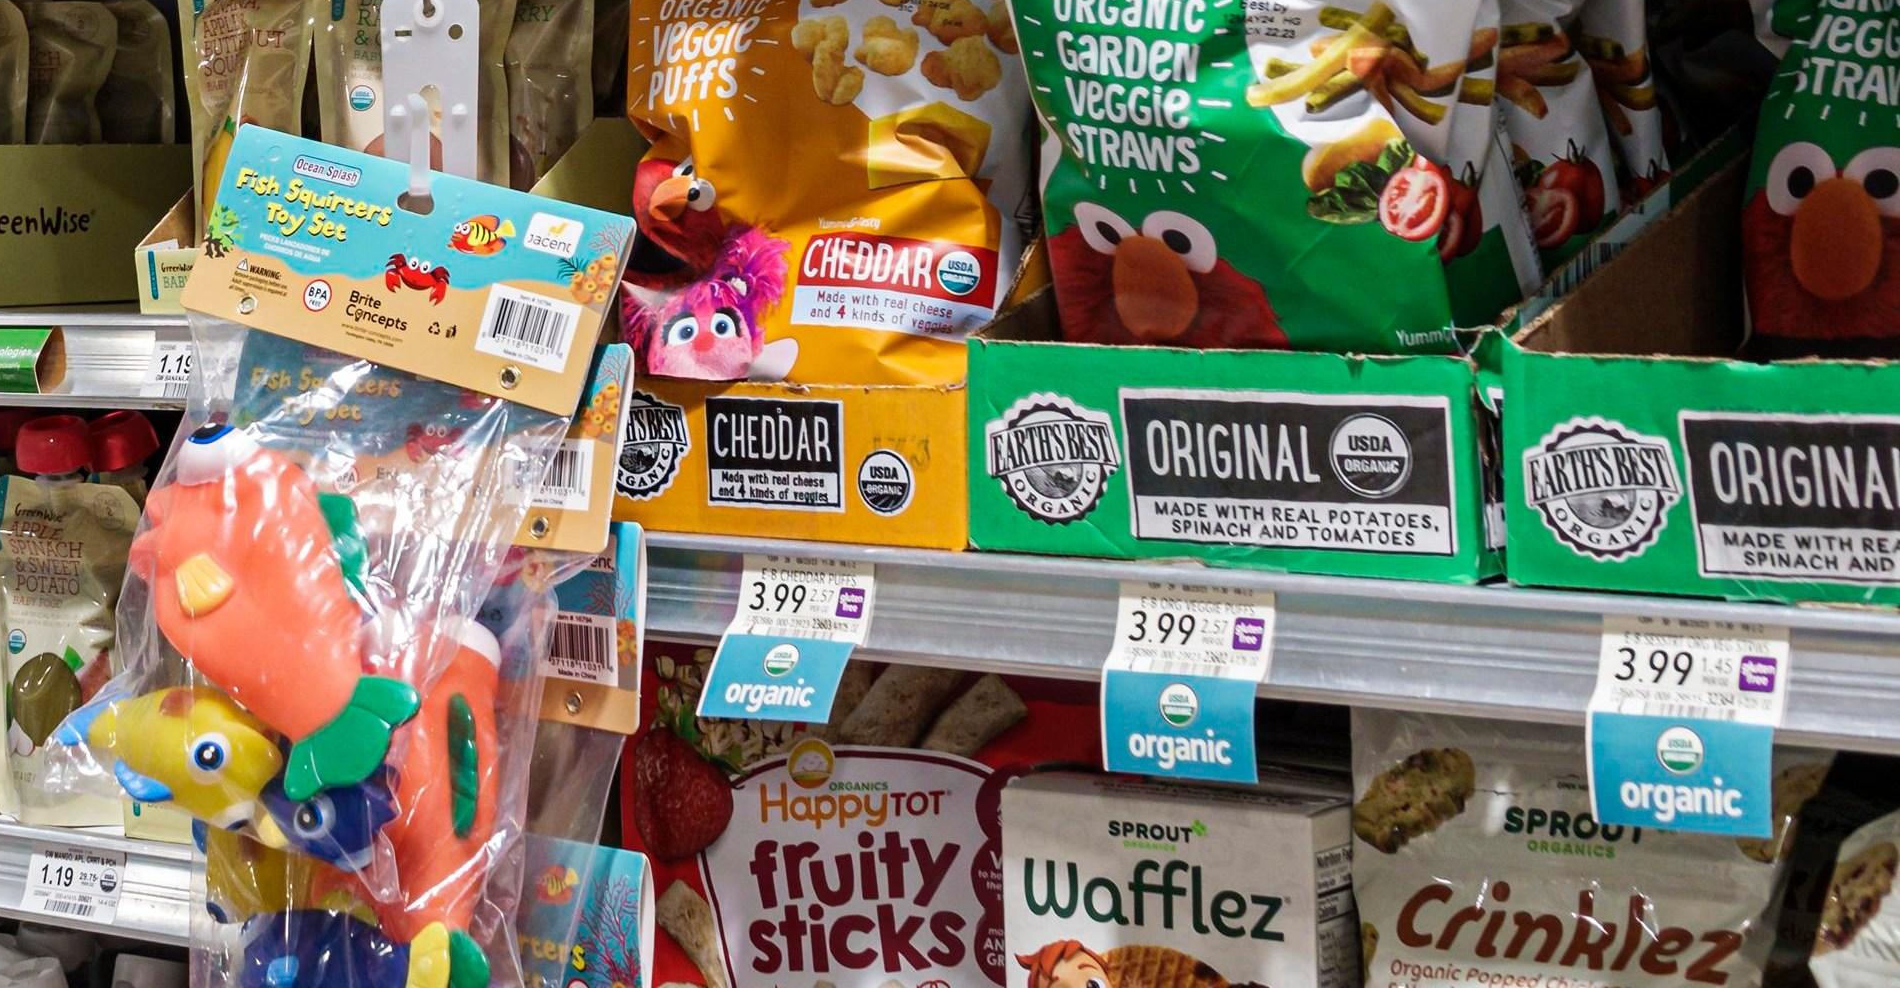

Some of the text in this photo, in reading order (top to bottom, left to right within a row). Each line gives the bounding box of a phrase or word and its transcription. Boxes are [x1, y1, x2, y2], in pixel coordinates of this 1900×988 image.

[1066, 122, 1201, 174] STRAWS
[297, 159, 358, 183] Ocean Splash
[236, 168, 392, 225] Fish Squirters
[267, 202, 347, 242] Toy Set
[250, 265, 282, 280] WARNING:
[804, 237, 932, 289] CHEDDAR
[308, 287, 327, 300] BPA
[350, 290, 381, 309] Brite
[817, 290, 952, 318] Made with real cheese
[713, 413, 832, 463] CHEDDAR
[1067, 421, 1111, 463] BEST
[1146, 419, 1321, 483] ORIGINAL
[870, 466, 899, 480] USDA
[1344, 458, 1400, 474] ORGANIC
[1155, 501, 1440, 532] MADE WITH REAL POTATOES,
[1172, 519, 1416, 547] SPINACH AND TOMATOES
[15, 575, 80, 595] POTATO
[749, 583, 807, 614] 3.99
[1128, 610, 1196, 646] 3.99
[1614, 647, 1693, 686] 3.99
[725, 679, 816, 712] organic
[1129, 729, 1232, 769] organic
[760, 782, 945, 830] HappyTOT
[1108, 819, 1192, 843] SPROUT
[41, 863, 74, 887] 1.19
[749, 830, 961, 909] fruity
[1023, 856, 1285, 942] Wafflez
[749, 903, 966, 974] sticks
[1395, 880, 1743, 986] Crinklez
